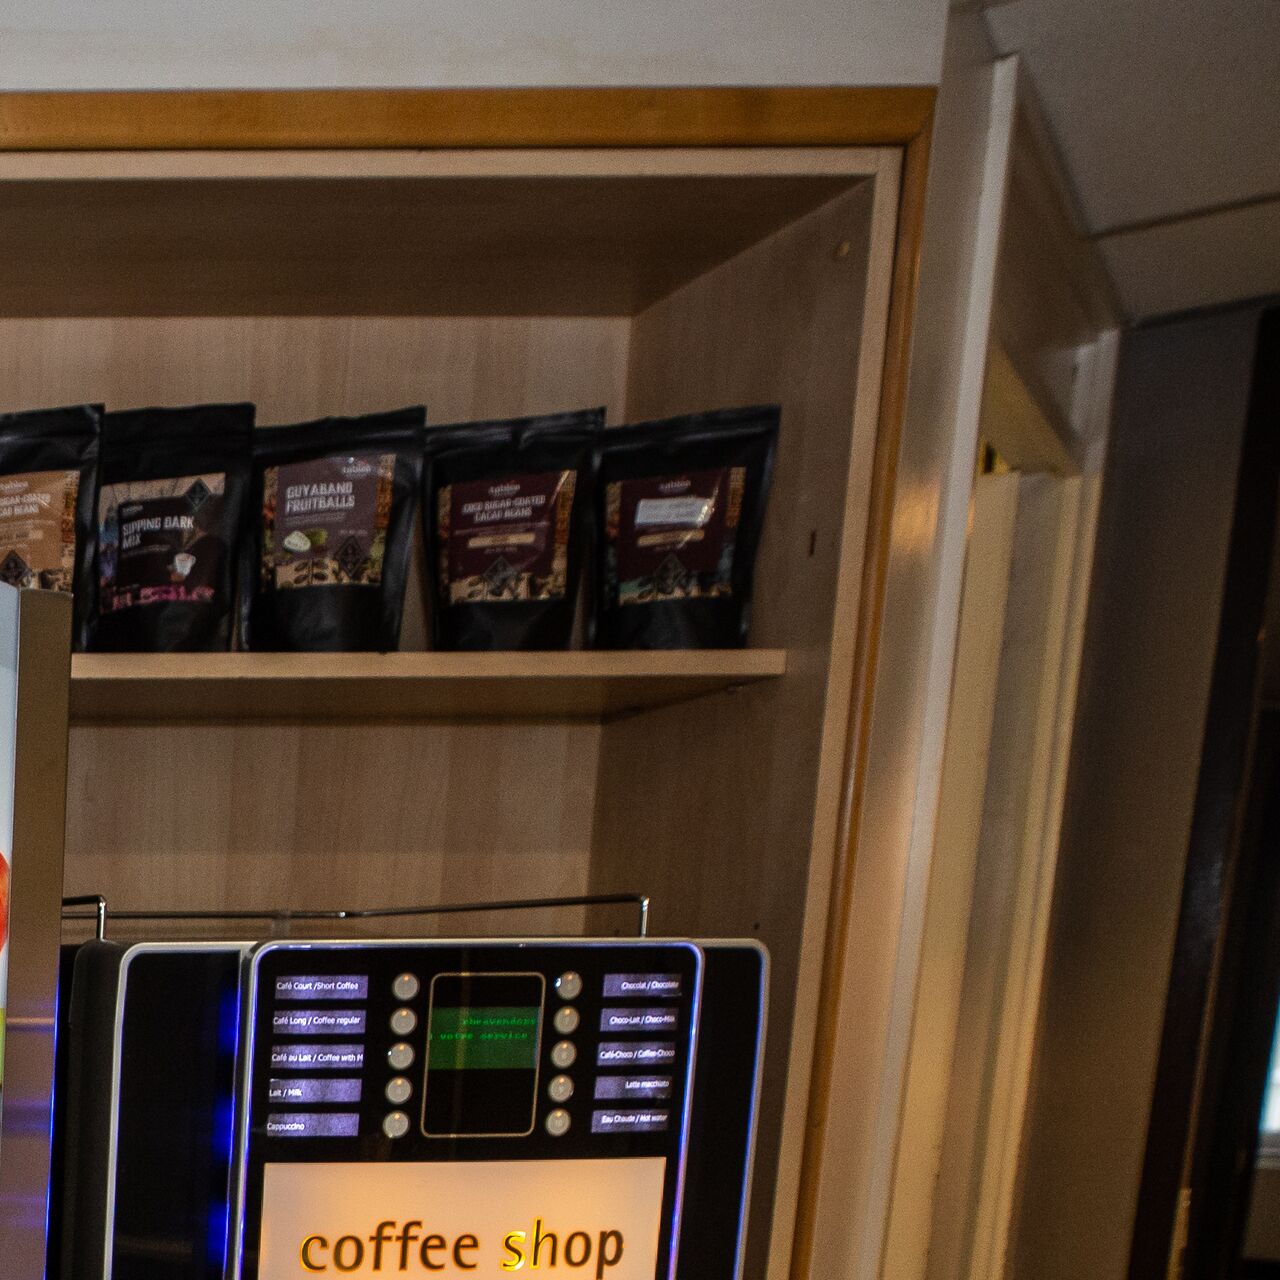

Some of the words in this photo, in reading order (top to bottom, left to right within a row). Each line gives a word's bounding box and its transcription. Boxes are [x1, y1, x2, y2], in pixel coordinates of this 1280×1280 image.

[286, 495, 355, 513] FRUITBALLS
[122, 517, 161, 536] SIPPING
[164, 515, 194, 529] DARK
[122, 533, 141, 549] MIX
[276, 982, 292, 990] Café
[293, 982, 312, 990] Court
[336, 982, 358, 990] Coffee
[273, 1016, 288, 1025] Café
[289, 1017, 307, 1026] Long
[313, 1016, 335, 1024] Coffee
[336, 1016, 360, 1026] regular
[318, 1053, 340, 1062] Coffee
[341, 1053, 355, 1062] with
[267, 1122, 304, 1131] Cappuccino
[300, 1220, 480, 1273] coffee
[501, 1216, 624, 1280] shop
